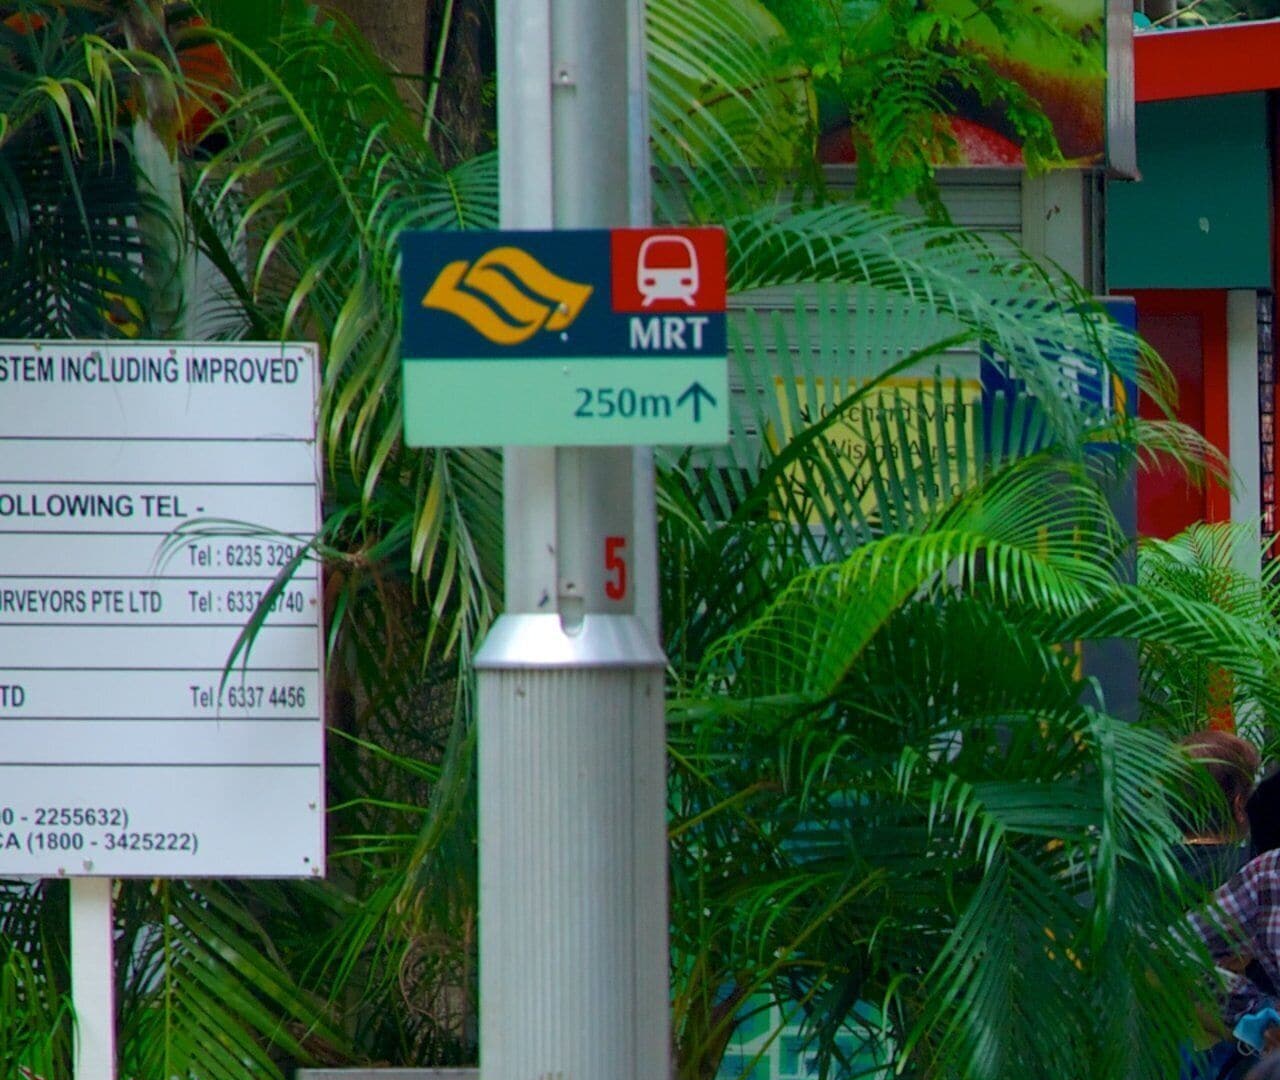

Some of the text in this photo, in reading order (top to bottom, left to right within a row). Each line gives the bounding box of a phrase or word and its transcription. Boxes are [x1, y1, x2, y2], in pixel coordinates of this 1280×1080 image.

[629, 317, 709, 349] MRT
[0, 356, 54, 382] STEM
[61, 356, 179, 383] INCLUDING
[573, 387, 672, 419] 250m
[0, 494, 134, 517] OLLOWING
[140, 494, 188, 518] TEL
[188, 544, 212, 567] Tel
[226, 544, 262, 567] 6235
[267, 544, 301, 567] 329
[605, 536, 627, 600] 5
[0, 590, 162, 613] RVEYORS PTE LTD
[188, 590, 213, 613] Tel
[190, 685, 213, 708] Tel
[228, 686, 264, 708] 6337
[269, 686, 306, 709] 4456
[35, 807, 129, 830] 2255632)
[0, 832, 21, 850] A
[27, 831, 84, 855] (1800
[104, 832, 199, 855] 3425222)
